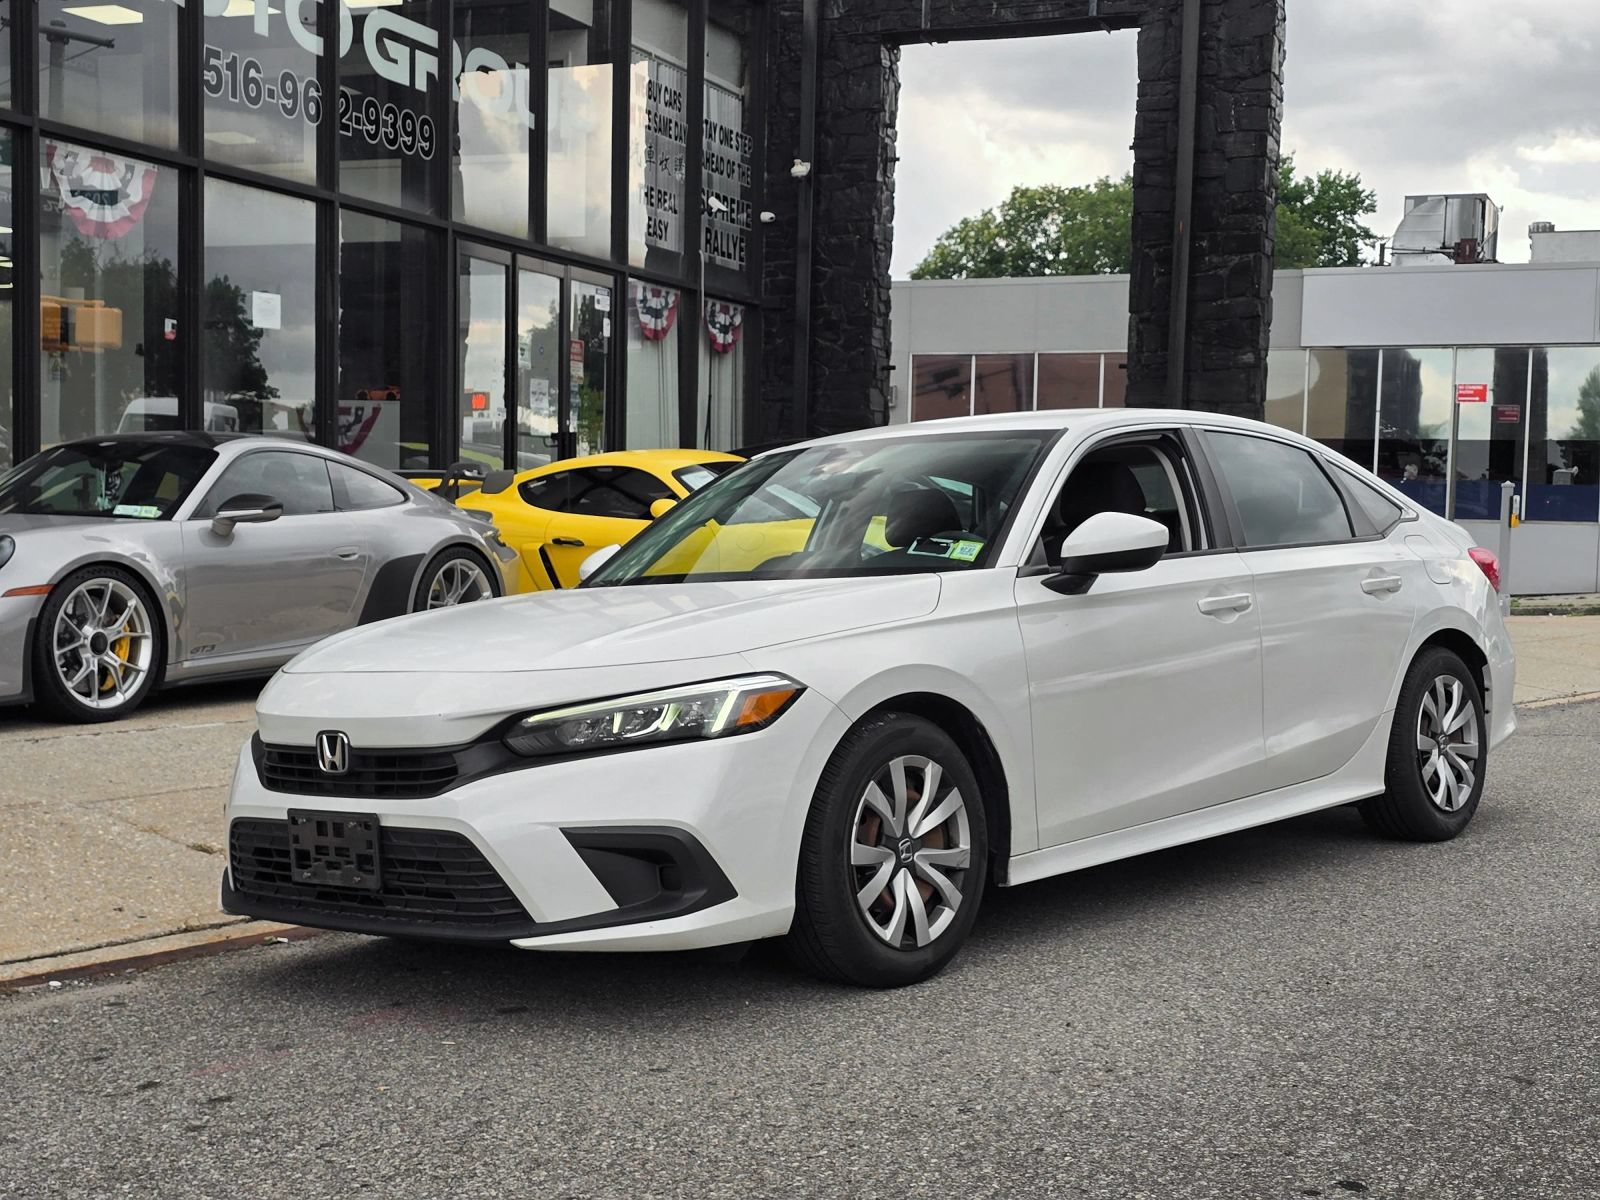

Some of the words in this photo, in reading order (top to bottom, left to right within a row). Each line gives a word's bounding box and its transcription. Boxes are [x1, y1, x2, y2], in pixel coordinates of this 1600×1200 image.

[204, 44, 435, 160] 516-962-9399
[648, 79, 663, 104] BUY
[664, 85, 682, 112] CARS
[653, 111, 673, 139] SAME
[674, 120, 688, 144] DAY
[703, 118, 718, 143] TAY
[719, 125, 733, 149] ONE
[735, 131, 752, 155] STEP
[726, 159, 736, 179] OF
[738, 162, 751, 187] THE
[657, 188, 678, 214] REAL
[701, 188, 752, 231] SUPREME
[647, 215, 669, 241] EASY
[705, 227, 745, 263] RALLYE
